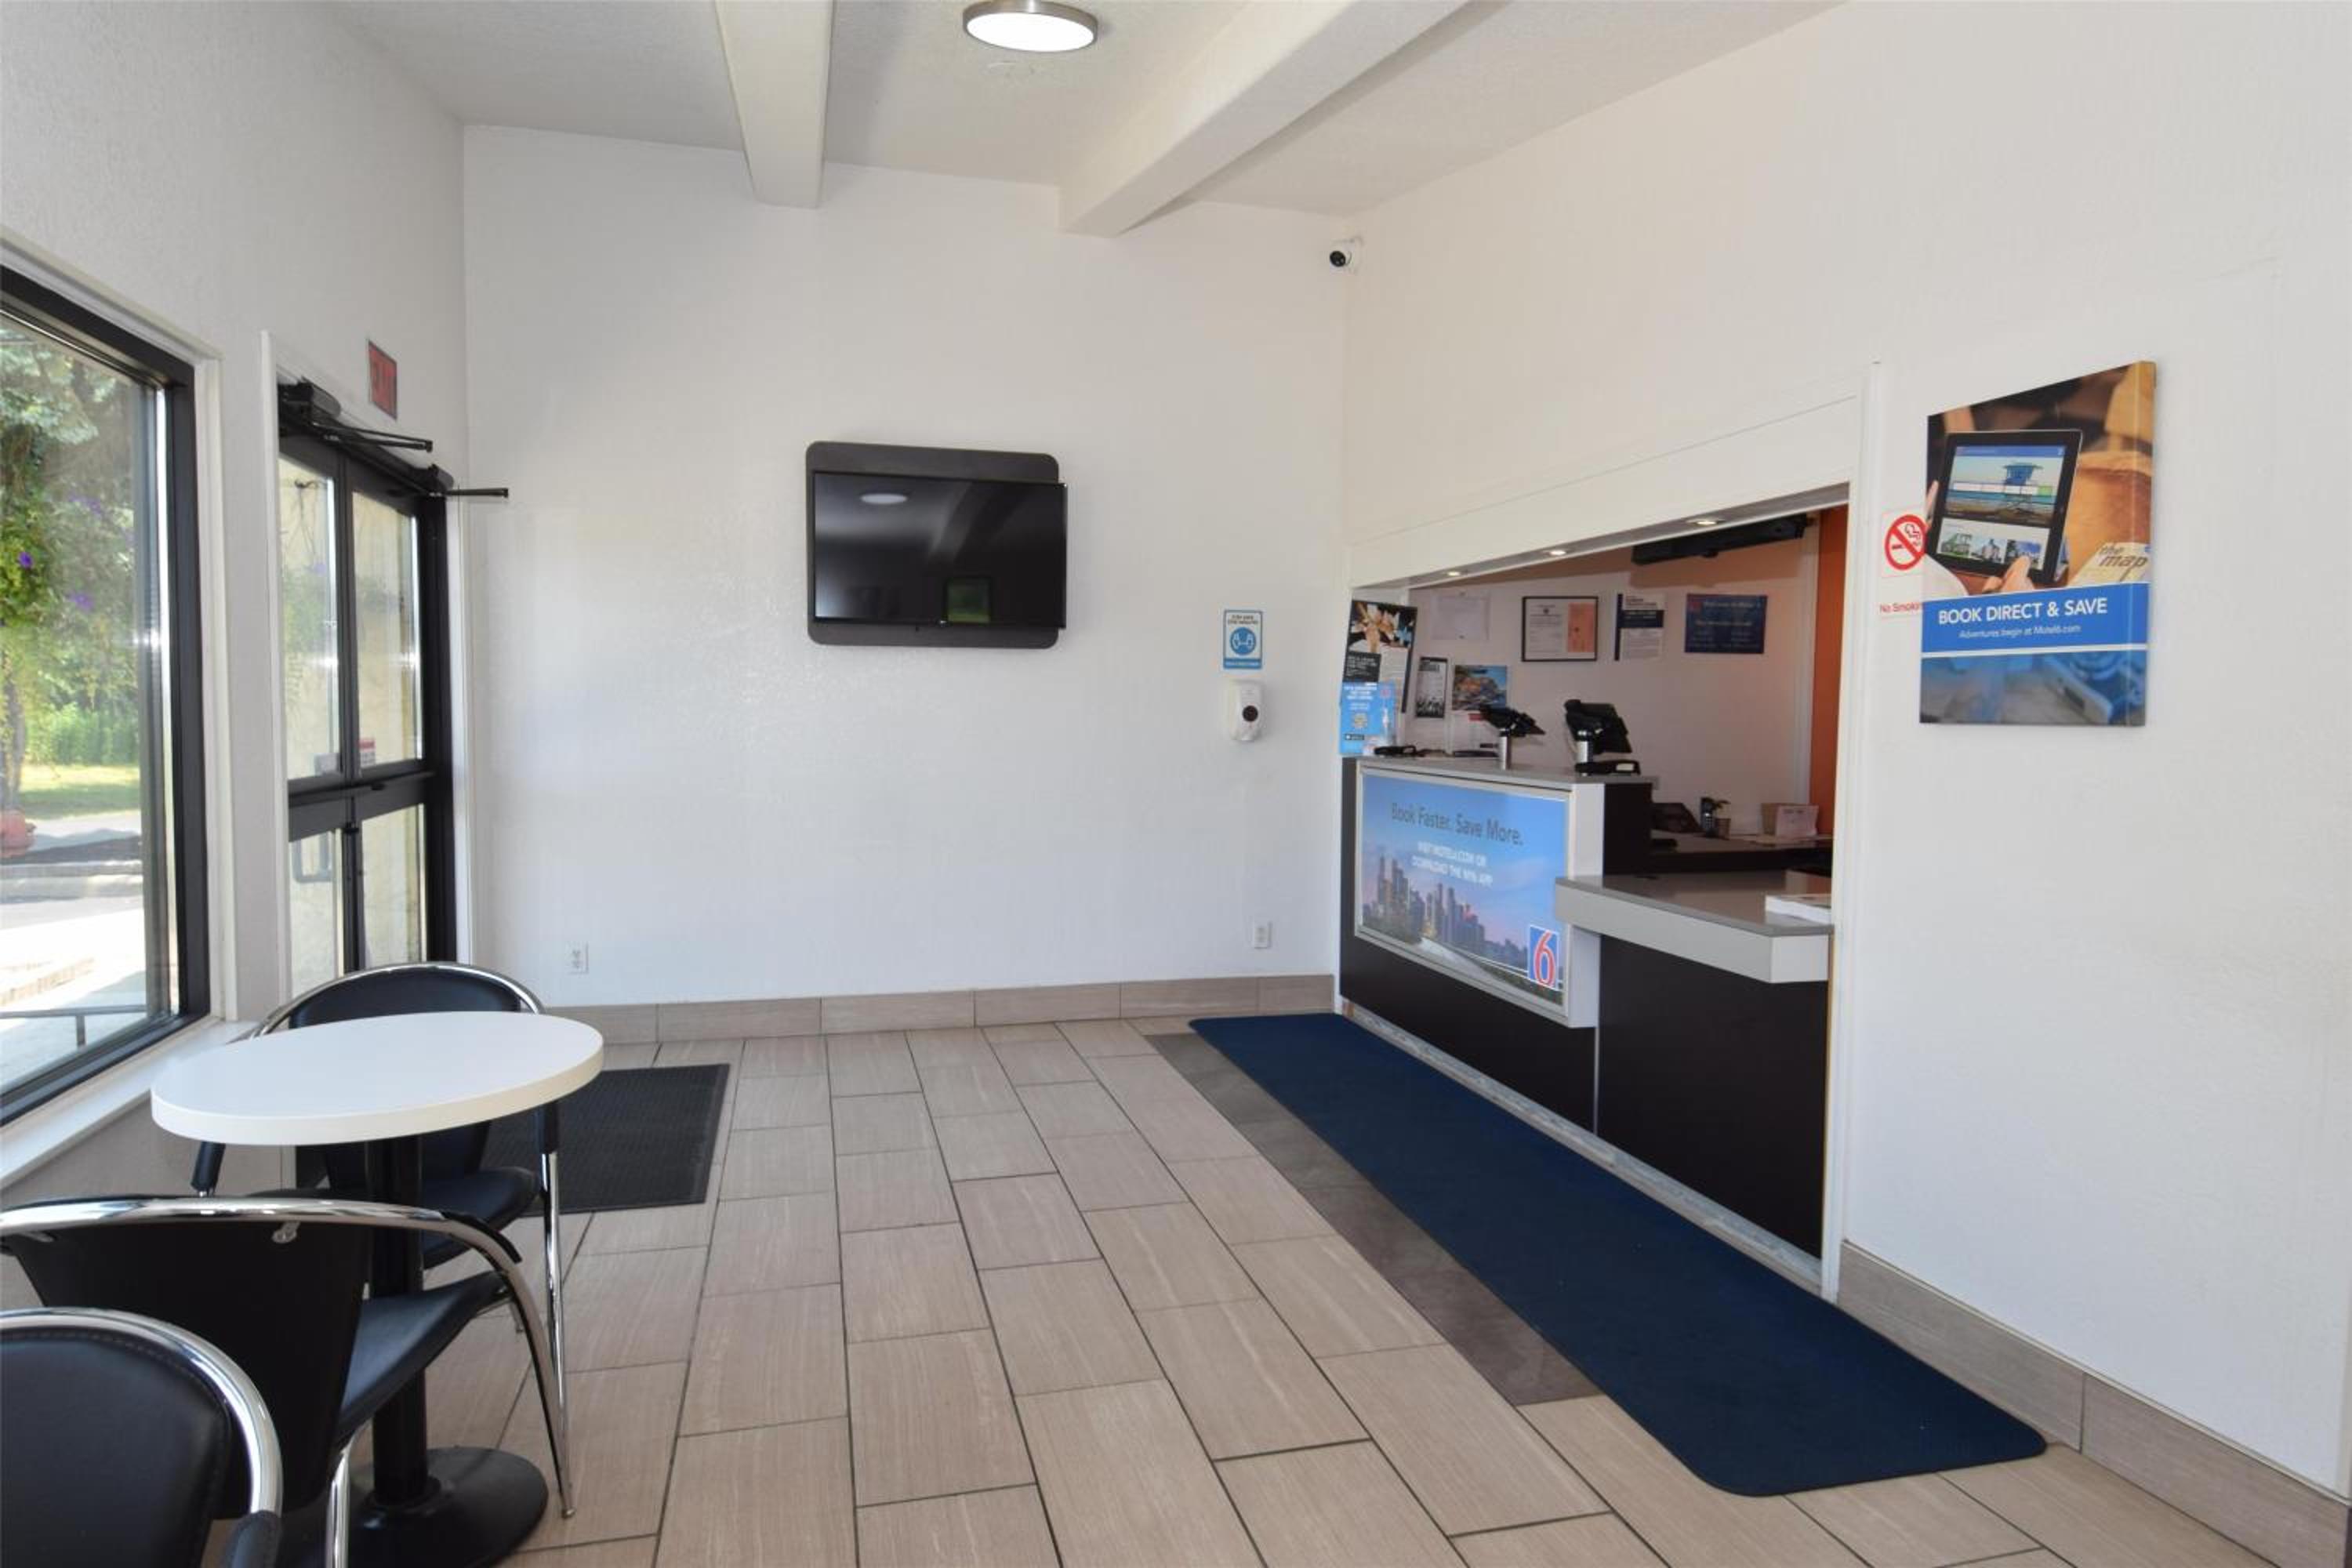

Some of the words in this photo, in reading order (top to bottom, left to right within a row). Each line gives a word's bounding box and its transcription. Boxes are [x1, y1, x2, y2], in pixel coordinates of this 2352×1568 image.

[2099, 555, 2148, 582] map
[1938, 606, 1982, 625] BOOK
[1986, 602, 2043, 622] DIRECT
[2047, 601, 2060, 617] &
[2064, 597, 2107, 615] SAVE
[1392, 802, 1416, 825] Book
[1417, 806, 1450, 829] Faster.
[1454, 812, 1483, 838] Save
[1486, 818, 1523, 846] More.
[1532, 930, 1556, 988] 6
